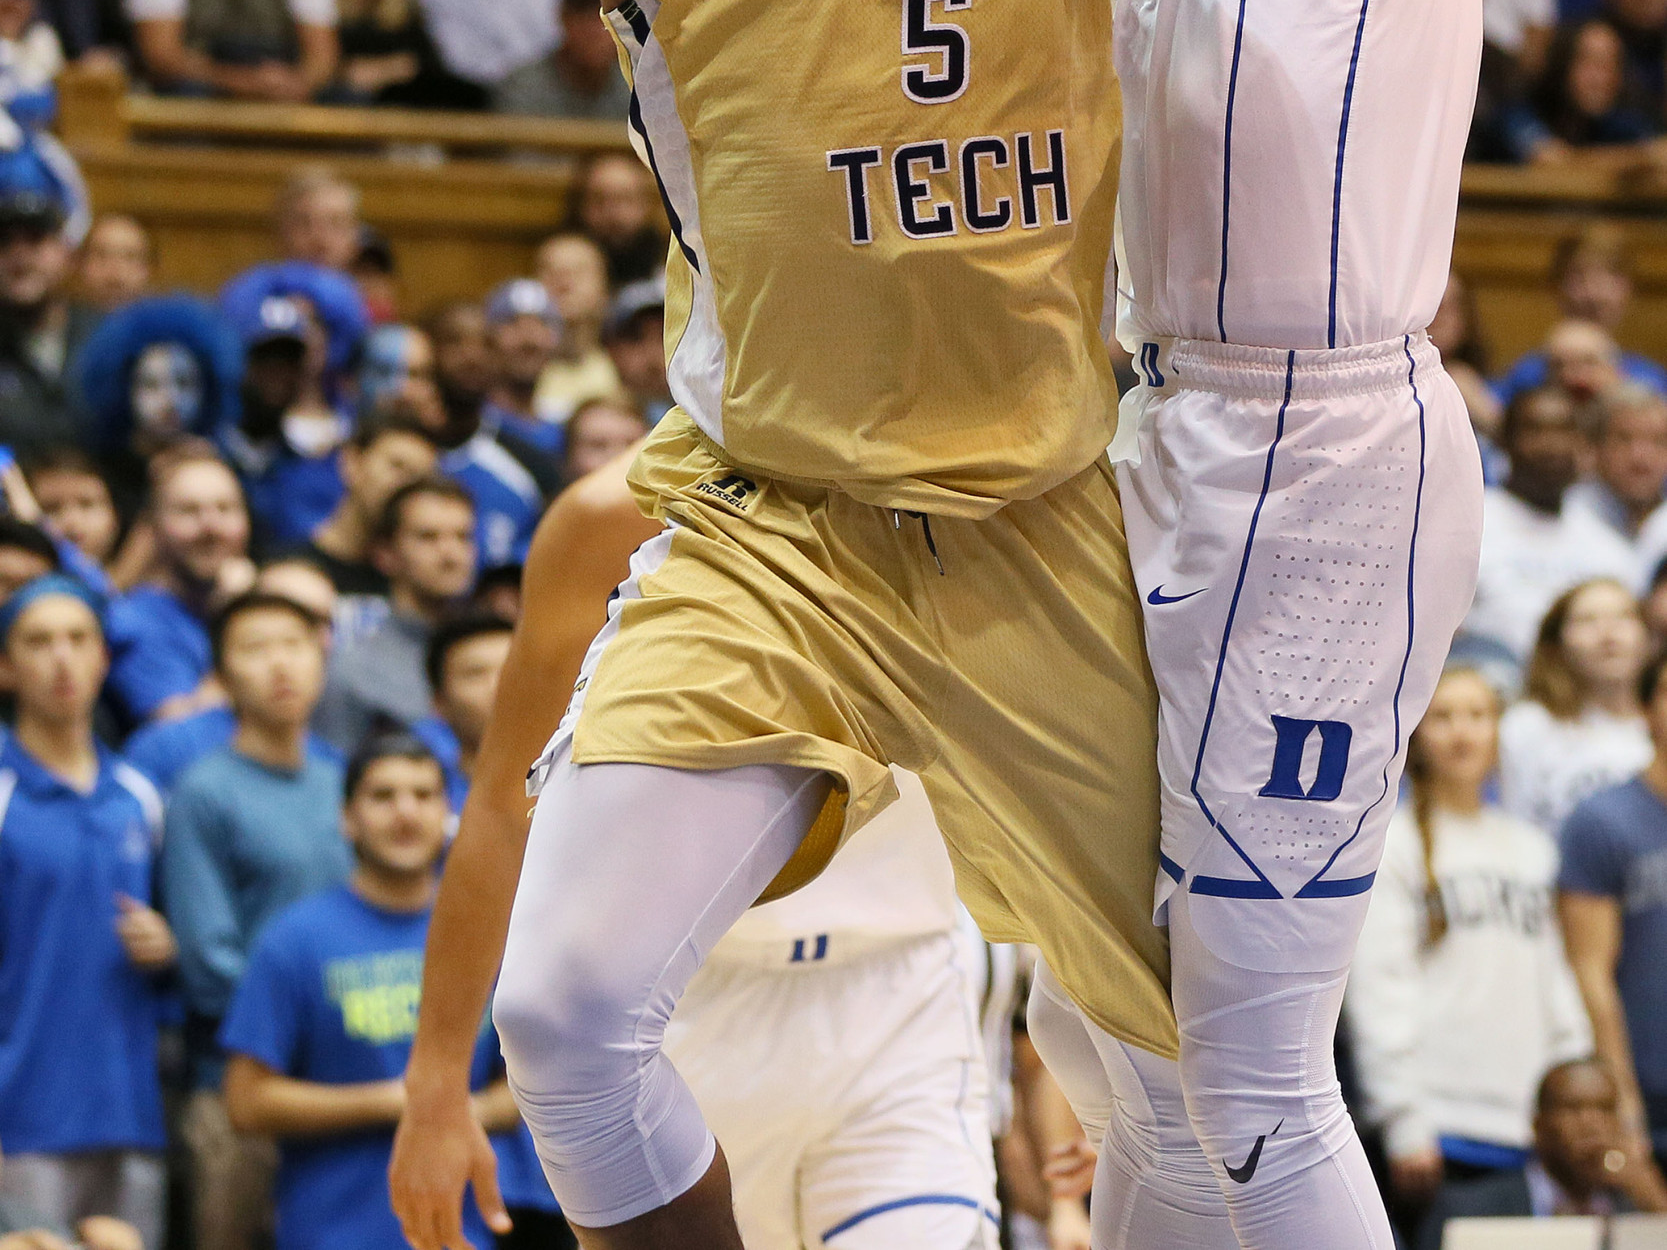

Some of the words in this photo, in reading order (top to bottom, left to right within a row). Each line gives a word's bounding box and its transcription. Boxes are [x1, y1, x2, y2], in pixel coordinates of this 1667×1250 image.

[826, 128, 1072, 244] TECH
[696, 482, 749, 511] RUSSELL
[1257, 714, 1353, 802] D
